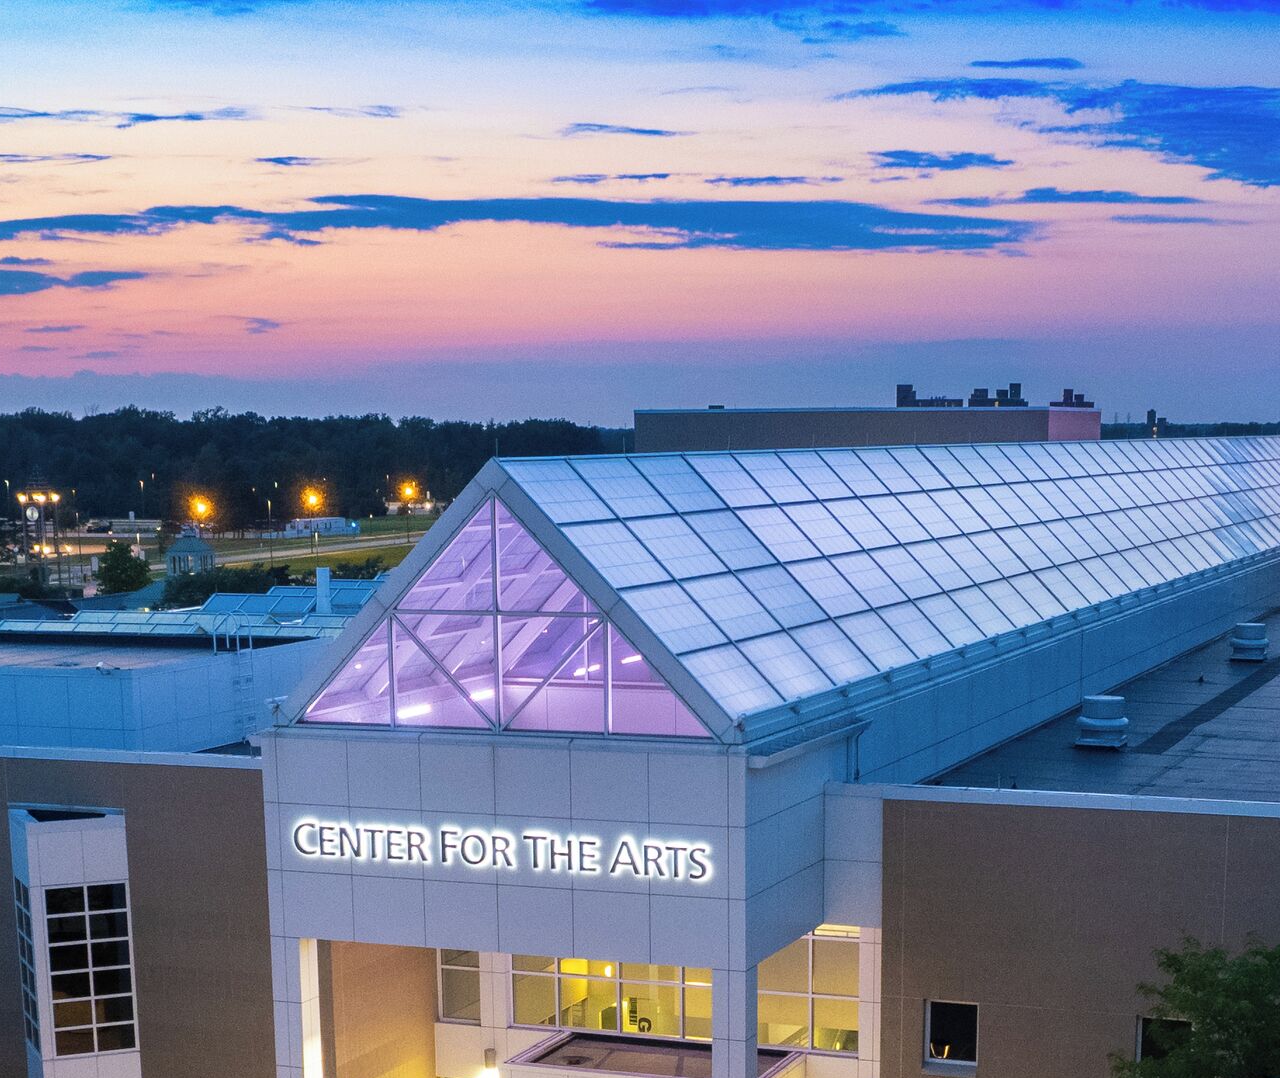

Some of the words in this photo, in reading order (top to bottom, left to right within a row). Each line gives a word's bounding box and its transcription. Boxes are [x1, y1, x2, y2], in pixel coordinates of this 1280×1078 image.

[292, 821, 428, 863] CENTER
[440, 830, 513, 867] FOR
[523, 834, 597, 872] THE
[609, 840, 708, 881] ARTS
